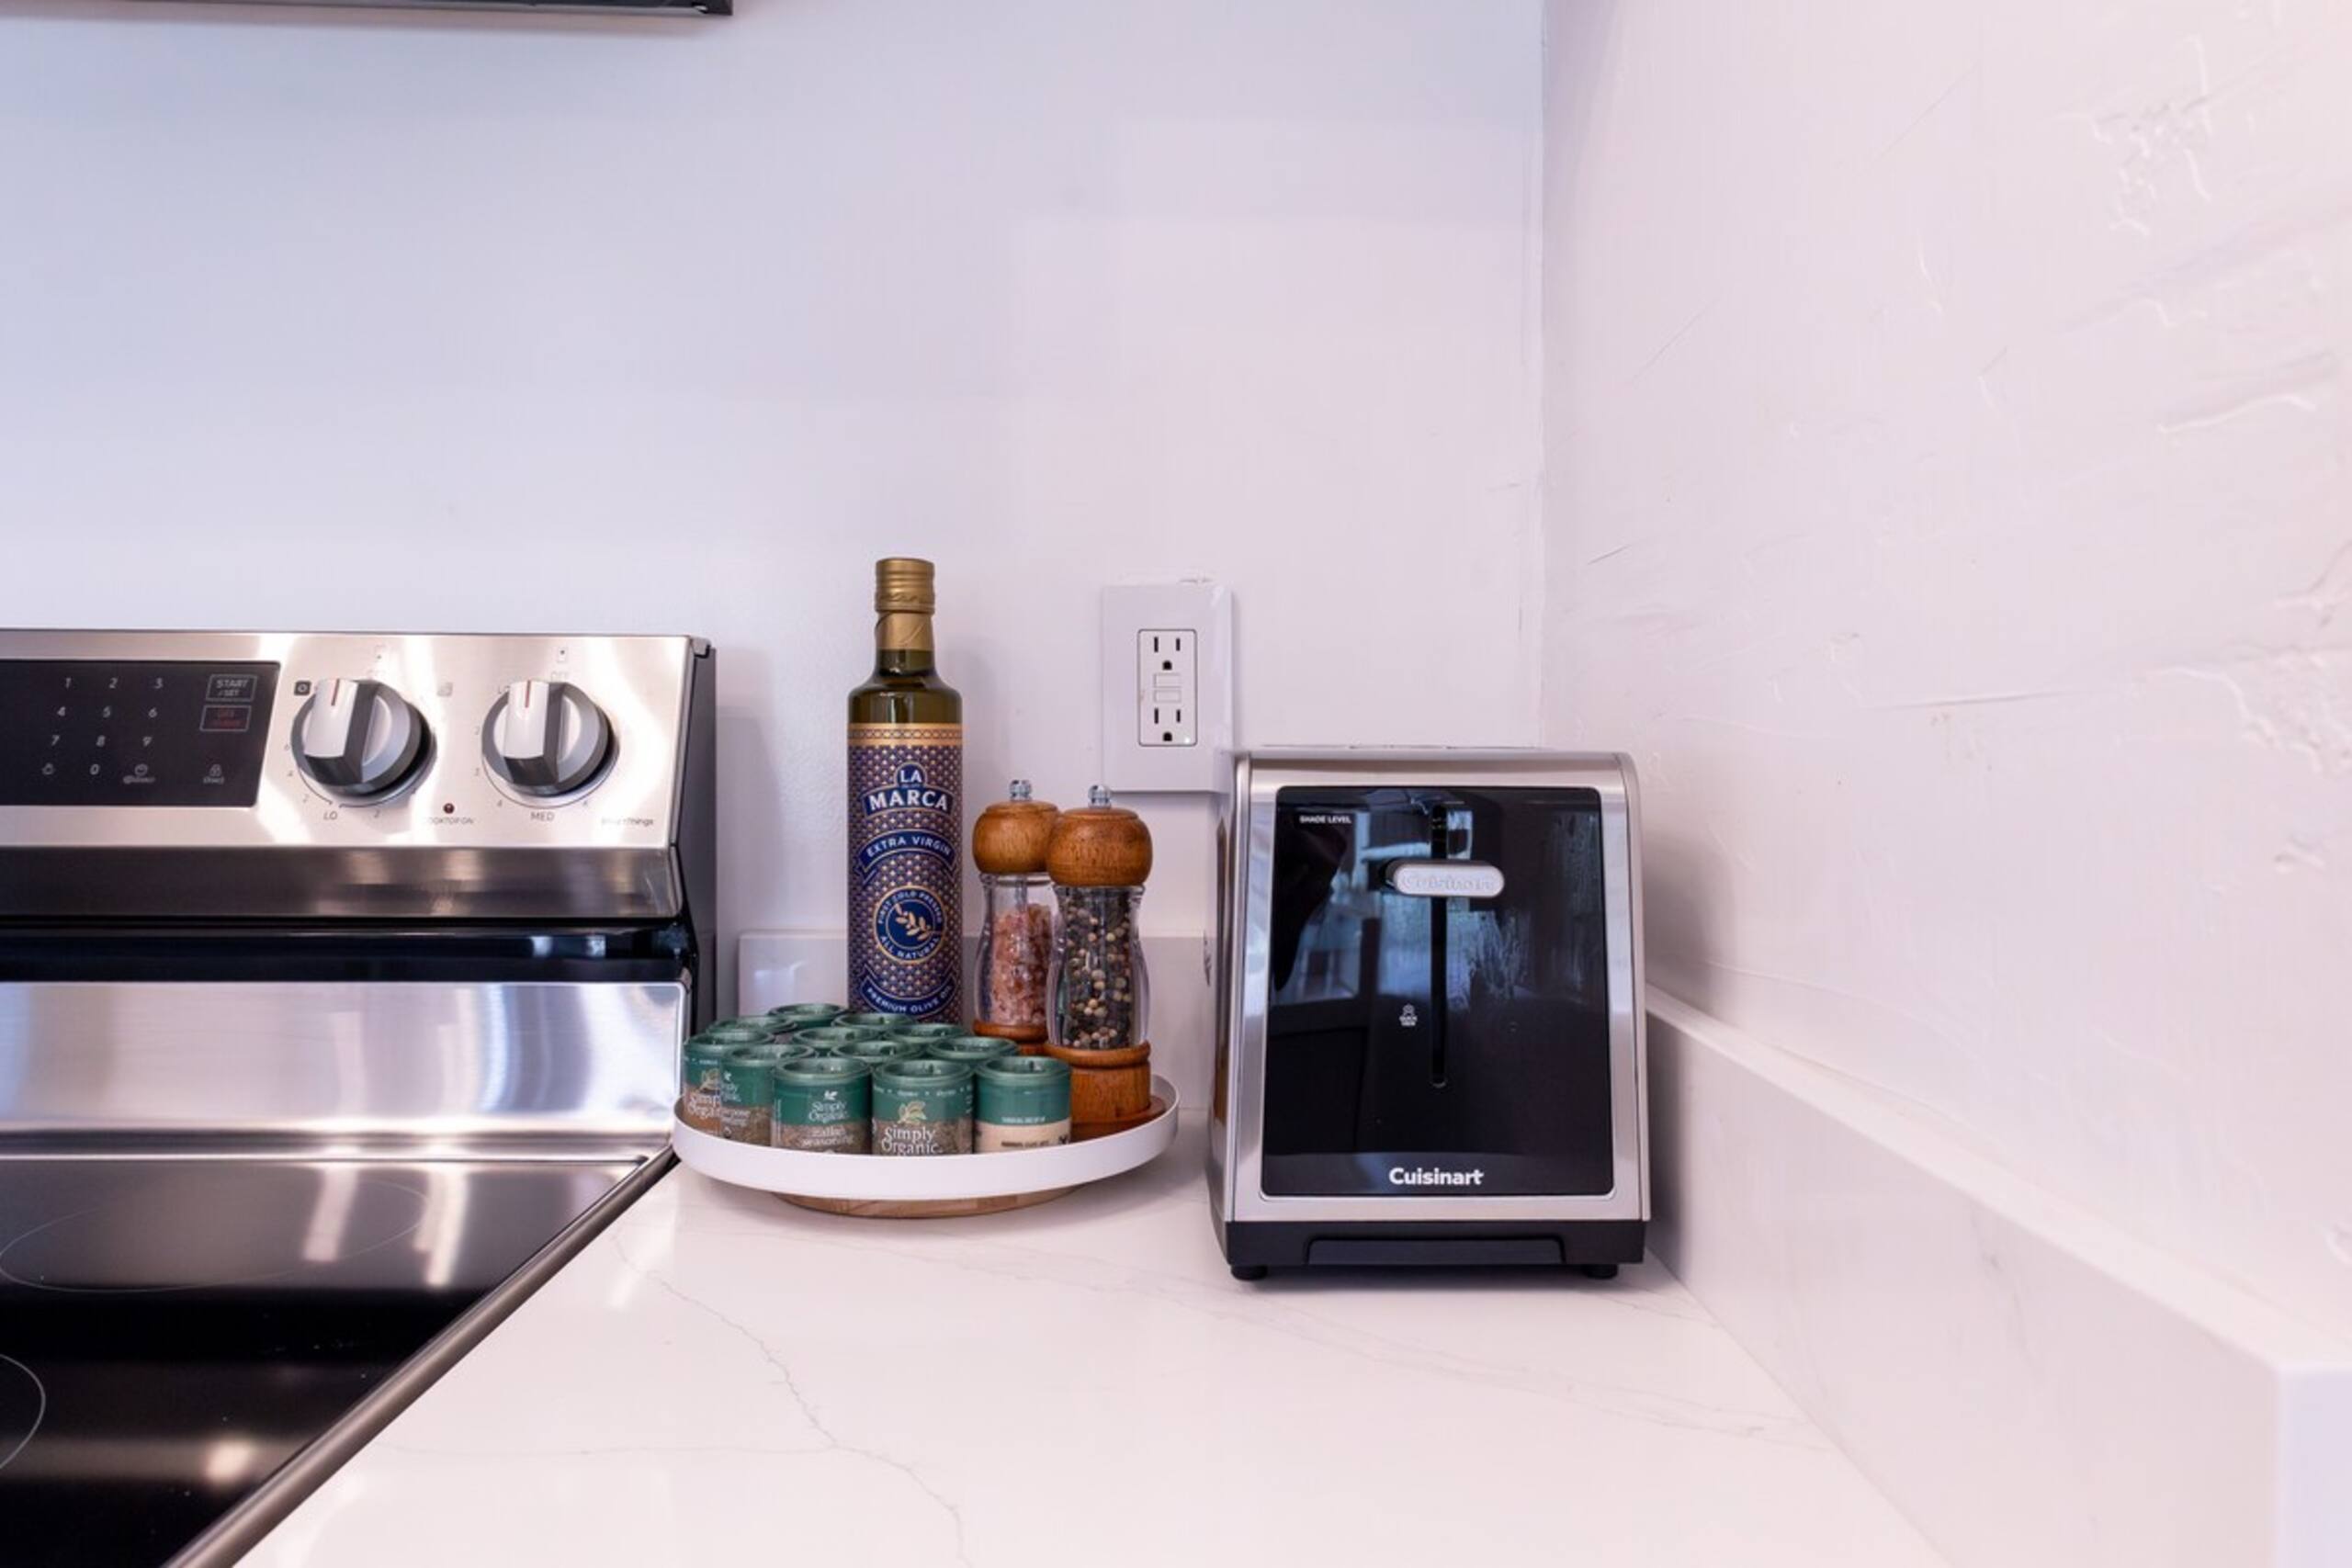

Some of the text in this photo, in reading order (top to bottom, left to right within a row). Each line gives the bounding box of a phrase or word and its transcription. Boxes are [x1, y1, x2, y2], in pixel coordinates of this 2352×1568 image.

[65, 678, 164, 689] 1 2 3
[216, 679, 249, 689] START
[57, 706, 158, 718] 4 5 6
[51, 735, 153, 747] 7 8 9
[90, 764, 100, 775] 0
[900, 770, 922, 783] LA
[869, 789, 948, 811] MARCA
[322, 811, 338, 820] LO
[530, 811, 555, 821] MED
[1299, 815, 1351, 824] SHADE LEVEL
[866, 837, 951, 858] EXTRA VIRGIN
[866, 987, 907, 1012] PREMIUM
[910, 997, 939, 1012] OLIVE
[883, 1124, 935, 1144] Simply
[881, 1138, 940, 1155] Organic
[1389, 1167, 1484, 1185] Cuisinart
